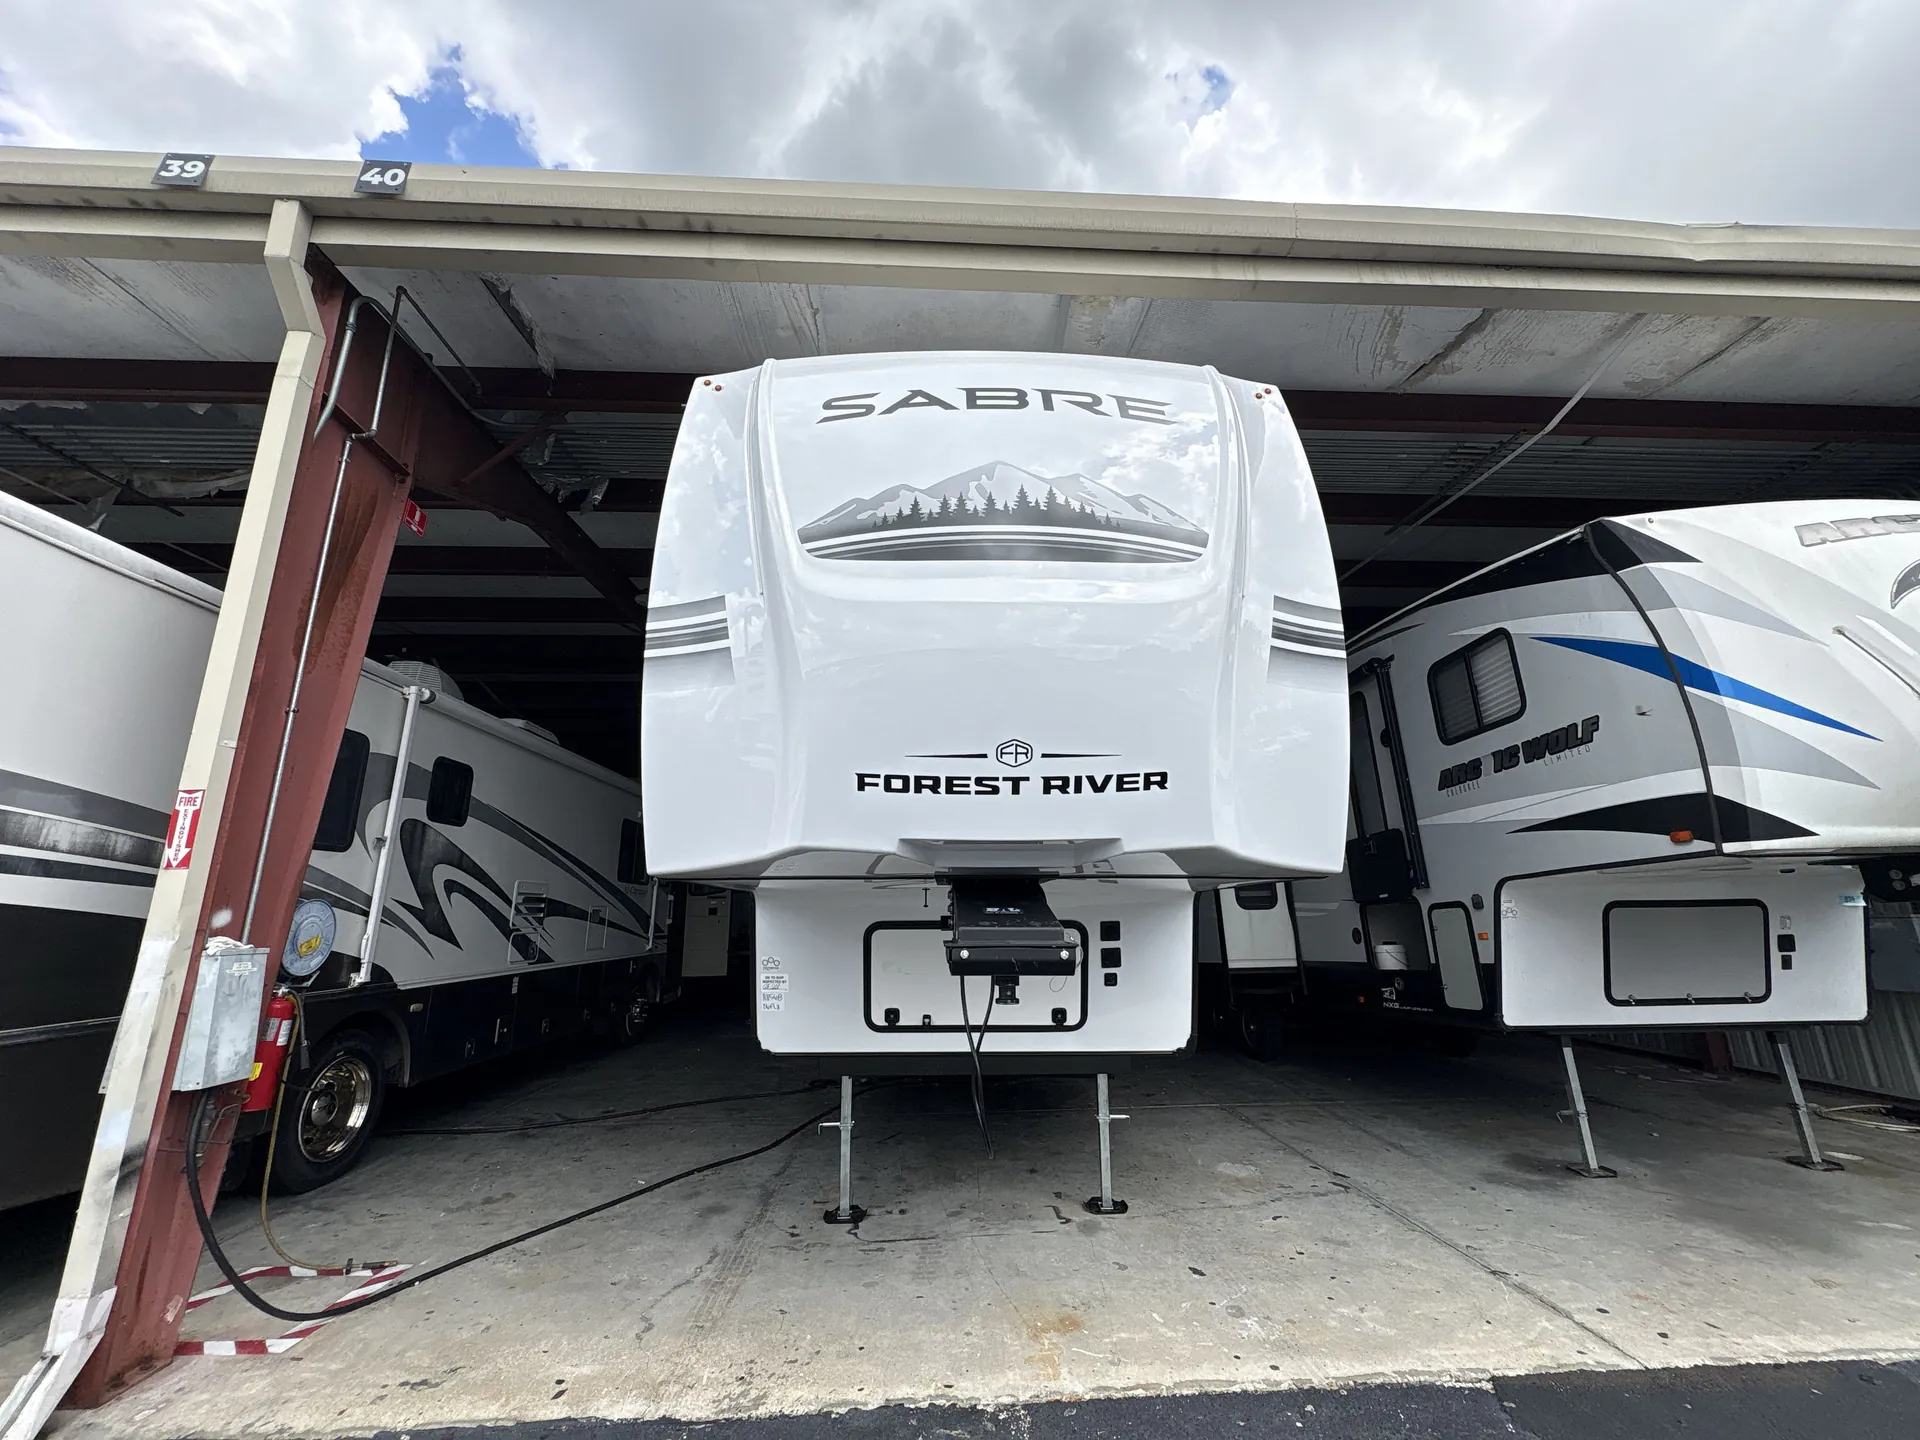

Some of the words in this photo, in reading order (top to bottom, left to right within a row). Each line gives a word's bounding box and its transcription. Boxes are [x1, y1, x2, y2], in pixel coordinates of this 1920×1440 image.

[158, 159, 206, 178] 39
[360, 167, 406, 186] 40
[815, 387, 1179, 427] SABRE
[1794, 513, 1920, 548] ARC
[1521, 714, 1600, 765] WOLF
[1543, 744, 1591, 767] LIMITED
[854, 772, 1030, 796] FOREST
[1040, 771, 1169, 795] RIVER
[178, 796, 200, 807] FIRE
[172, 808, 189, 862] EXTINGUISHER
